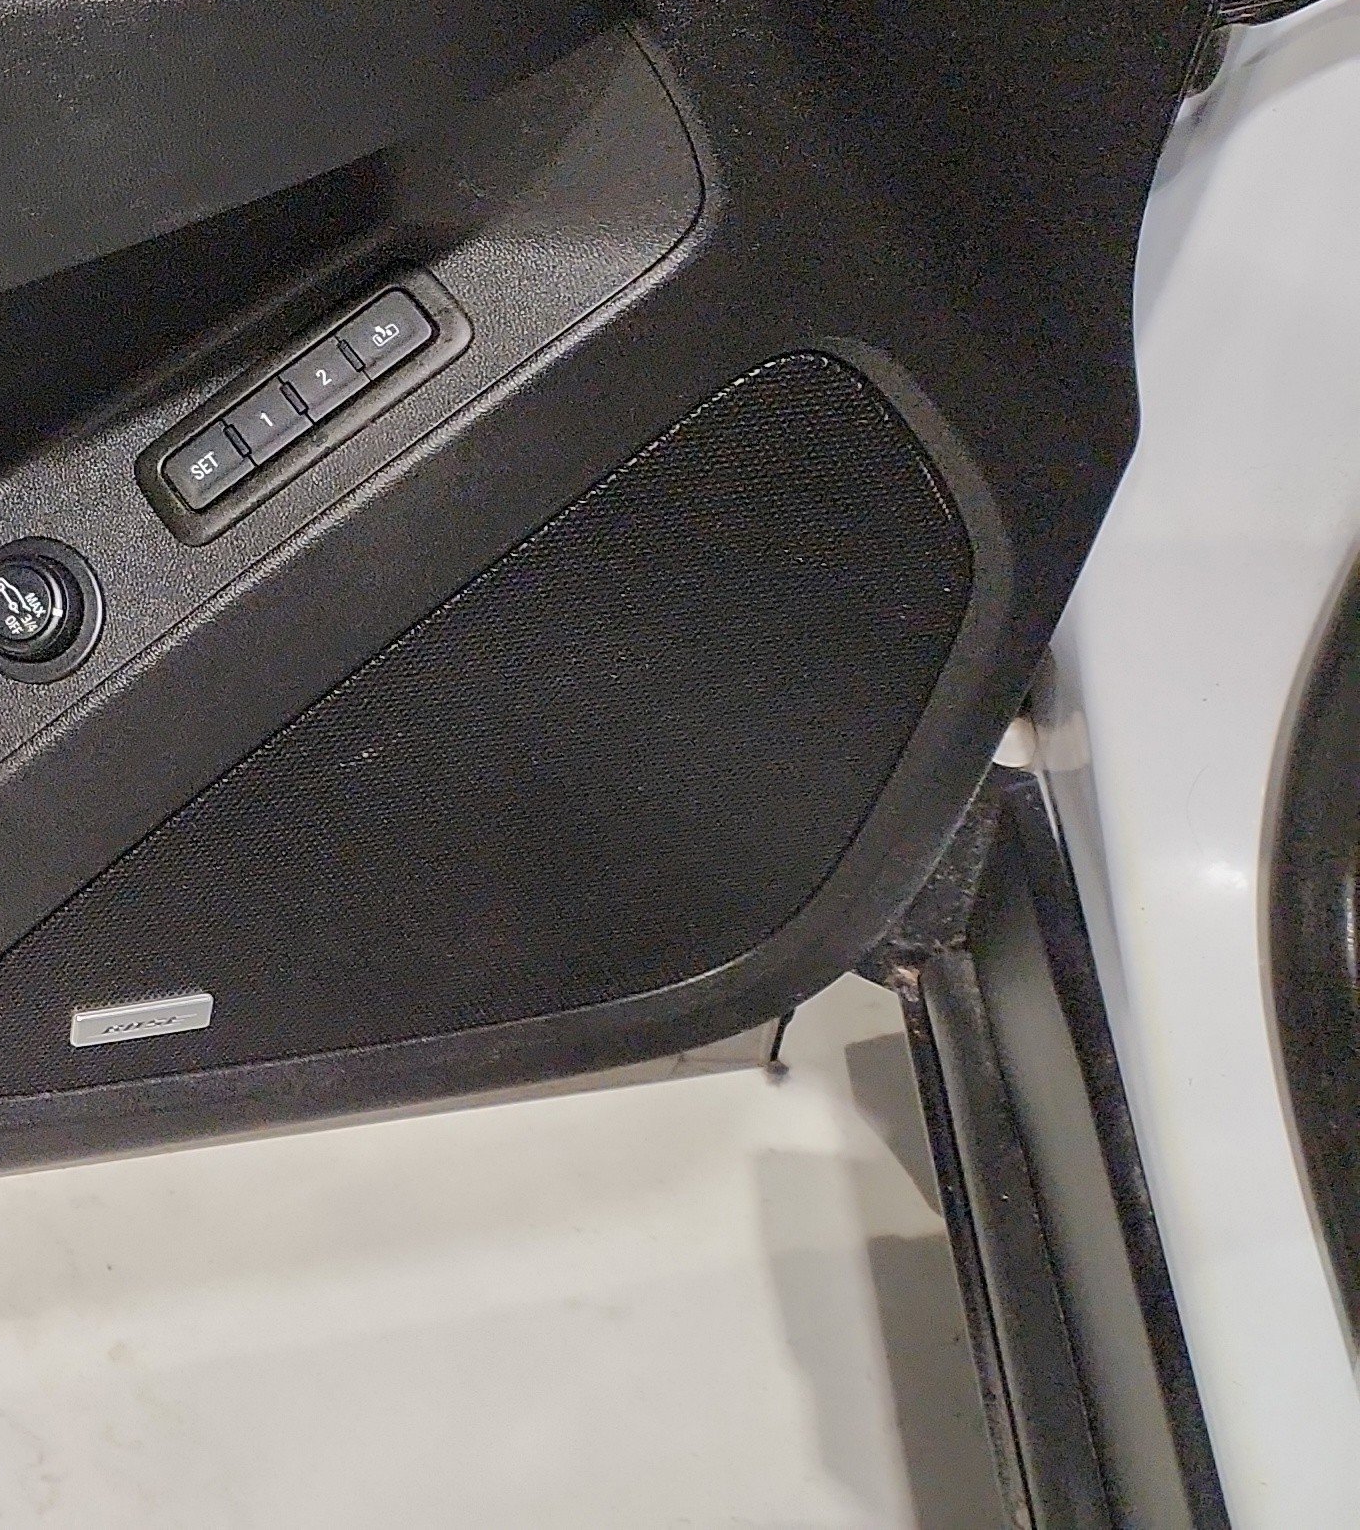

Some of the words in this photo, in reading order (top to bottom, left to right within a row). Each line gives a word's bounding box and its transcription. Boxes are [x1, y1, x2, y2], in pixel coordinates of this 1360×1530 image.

[315, 369, 332, 386] 2
[259, 412, 274, 427] 1
[190, 451, 220, 480] SET
[24, 592, 46, 618] MAX
[4, 614, 25, 635] OFF
